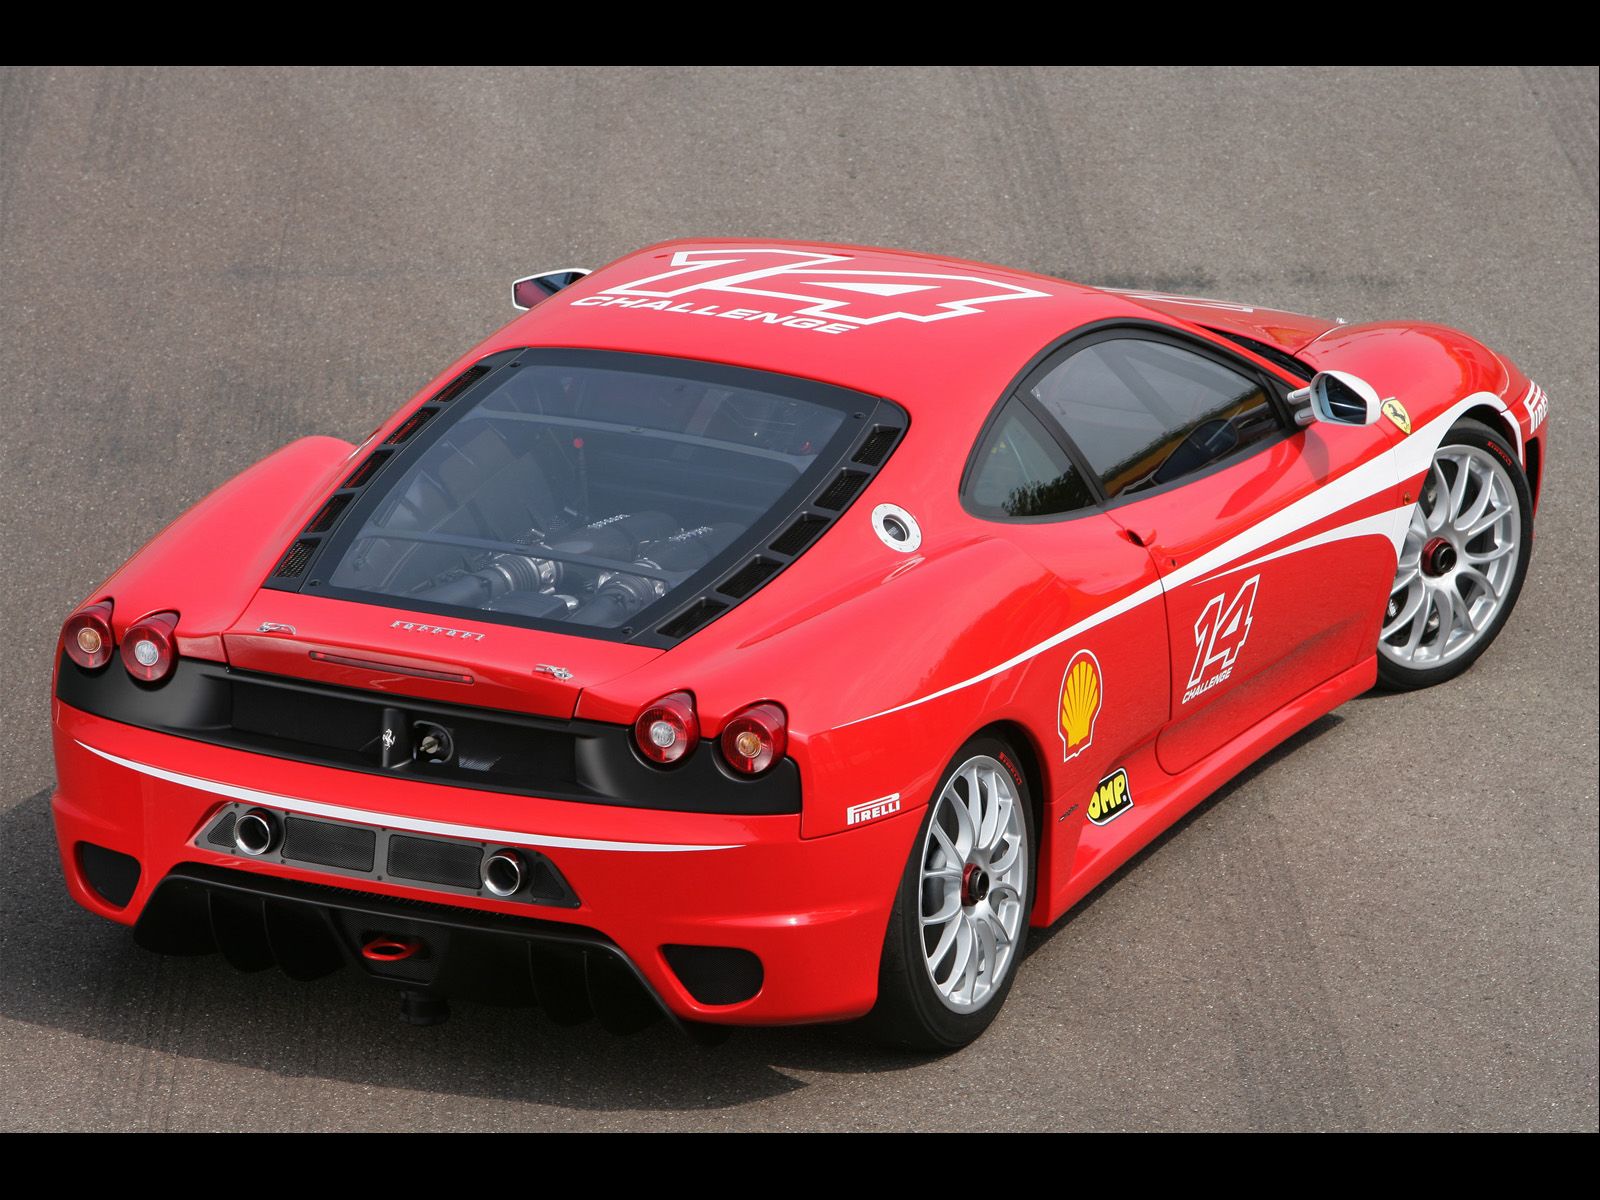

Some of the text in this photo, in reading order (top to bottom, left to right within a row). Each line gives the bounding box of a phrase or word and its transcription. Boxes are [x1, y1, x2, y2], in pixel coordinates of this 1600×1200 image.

[596, 248, 1054, 325] 14
[570, 295, 860, 335] CHALLENGE
[1186, 573, 1261, 691] 14
[1181, 666, 1233, 705] CHALLENGE
[847, 792, 901, 826] PIRELLI
